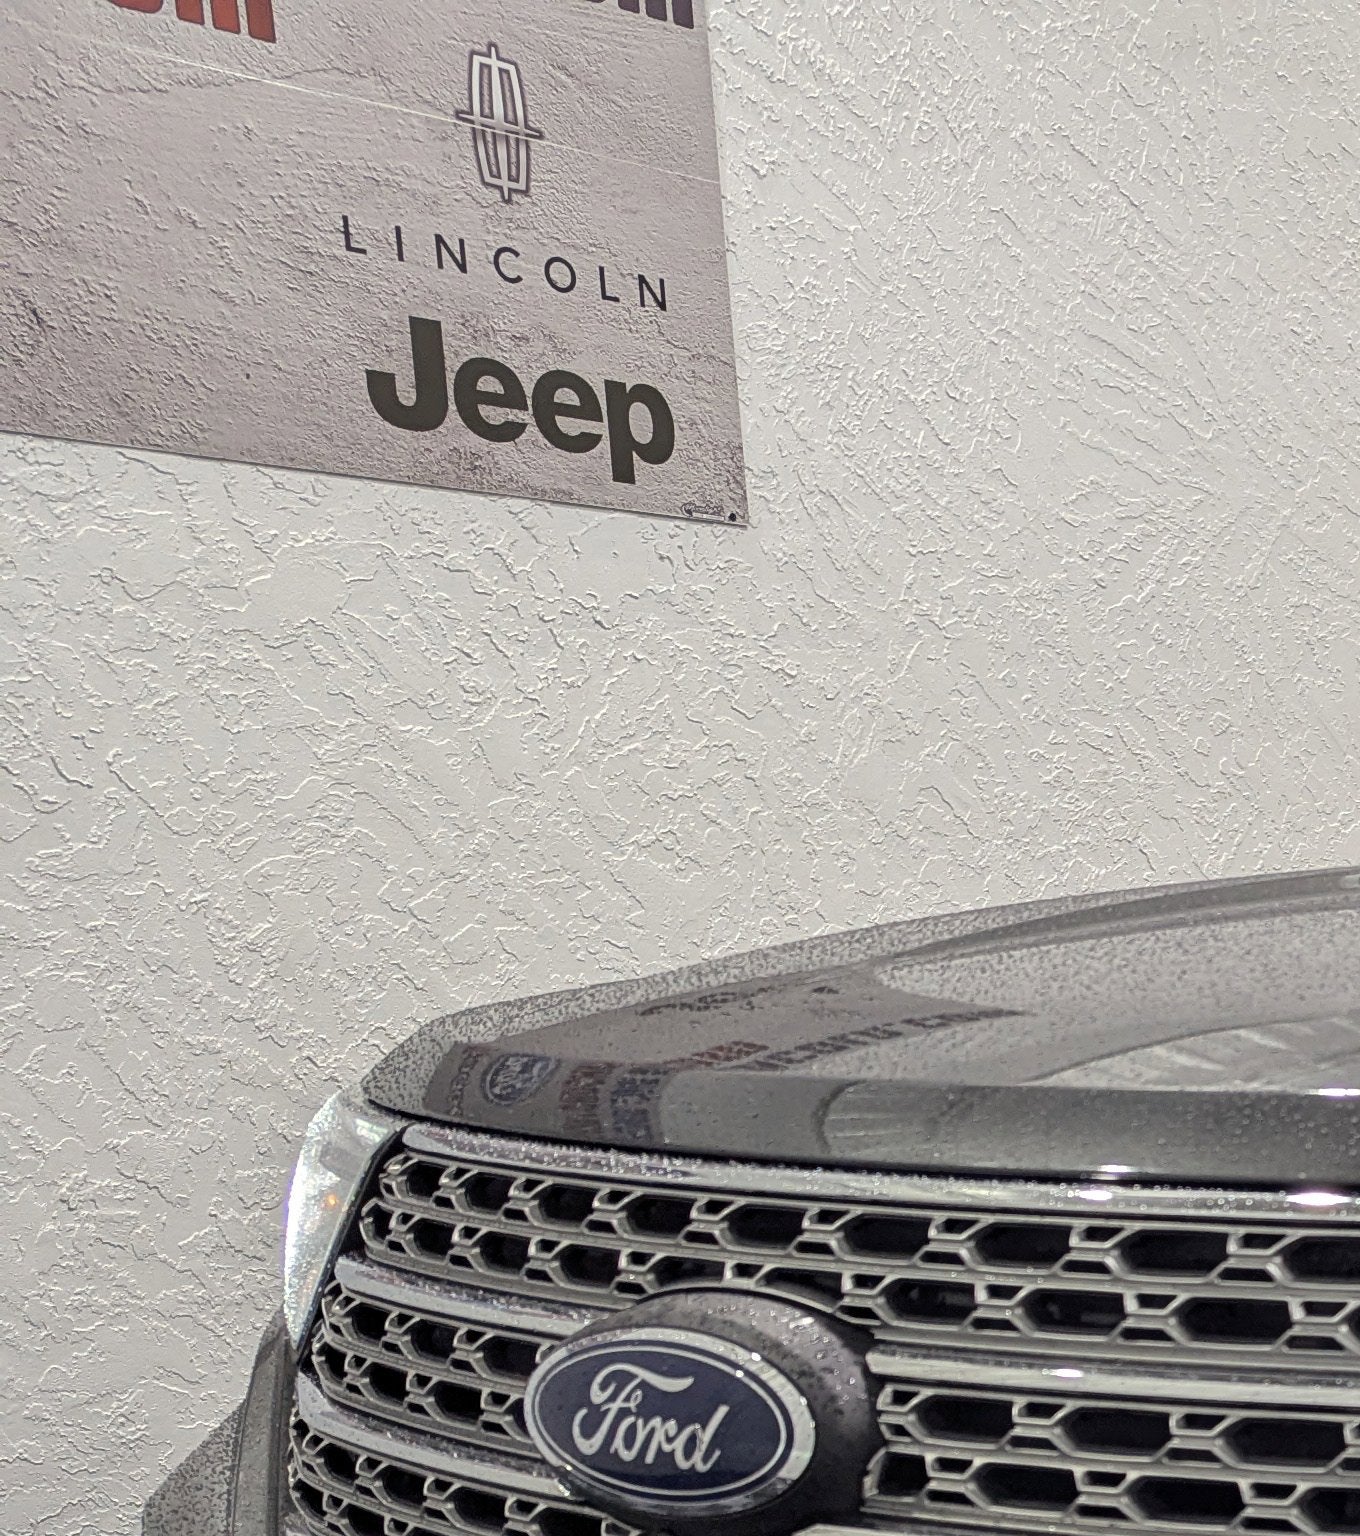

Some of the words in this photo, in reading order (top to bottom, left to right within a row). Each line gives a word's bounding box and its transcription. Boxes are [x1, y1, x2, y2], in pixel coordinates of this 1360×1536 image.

[341, 214, 669, 312] LINCOLN
[364, 315, 676, 485] Jeep
[571, 1362, 731, 1473] Ford
